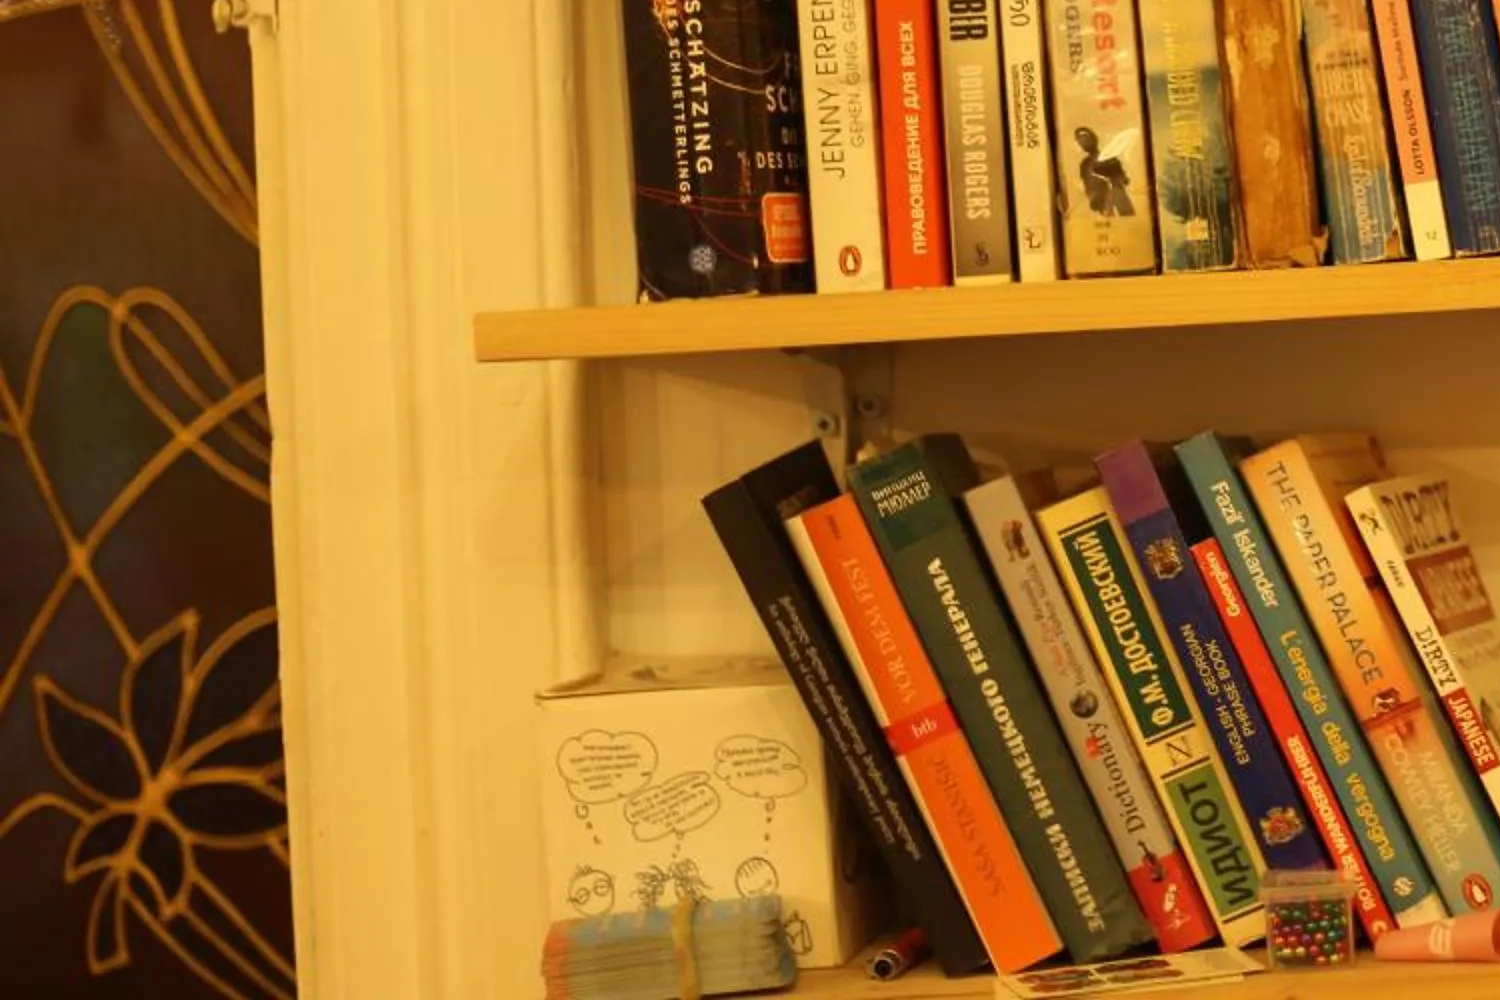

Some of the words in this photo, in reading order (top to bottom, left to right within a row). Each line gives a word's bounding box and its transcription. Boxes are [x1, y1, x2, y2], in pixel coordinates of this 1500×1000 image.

[898, 20, 916, 66] ВСЕХ
[667, 39, 692, 205] SCHMETTERLINGS
[901, 69, 921, 109] ДЛЯ
[956, 64, 986, 146] DOUGLAS
[1400, 88, 1418, 137] OLSSON
[816, 85, 845, 180] JENNY
[1409, 138, 1425, 176] LOTTA
[903, 113, 928, 254] ПРАВОВЕДЕНИЕ
[962, 150, 991, 220] ROGERS
[838, 554, 875, 604] FEST
[1073, 526, 1157, 677] ДОСТОЕВСКИЙ
[1199, 549, 1244, 618] Georgien
[1232, 528, 1282, 610] Iskander
[1264, 459, 1303, 514] THE
[1326, 590, 1385, 686] PALACE
[861, 603, 899, 656] DEM
[924, 554, 991, 676] ГЕНЕРАЛА
[884, 654, 922, 705] VOR
[1177, 621, 1222, 697] GEORGIAN
[1202, 638, 1232, 681] BOOK
[909, 715, 939, 740] btb
[1139, 672, 1177, 726] Ф.М.
[1212, 703, 1252, 766] ENGLISH
[1221, 679, 1258, 737] PHRASE
[1446, 691, 1497, 767] JAPANESE
[977, 674, 1056, 822] НЕМЕЦКОГО
[1078, 714, 1150, 836] Dictionary
[1275, 628, 1331, 717] L'energia
[1320, 717, 1355, 766] della
[1339, 771, 1396, 864] vergogna
[1283, 734, 1351, 855] WANDERFÜHRER
[1381, 732, 1433, 814] COWLEY
[1420, 811, 1462, 874] HELLER
[1416, 749, 1470, 837] MIRANDA
[1044, 819, 1107, 936] ЗАПИСКИ
[1176, 771, 1261, 911] ИДИОТ
